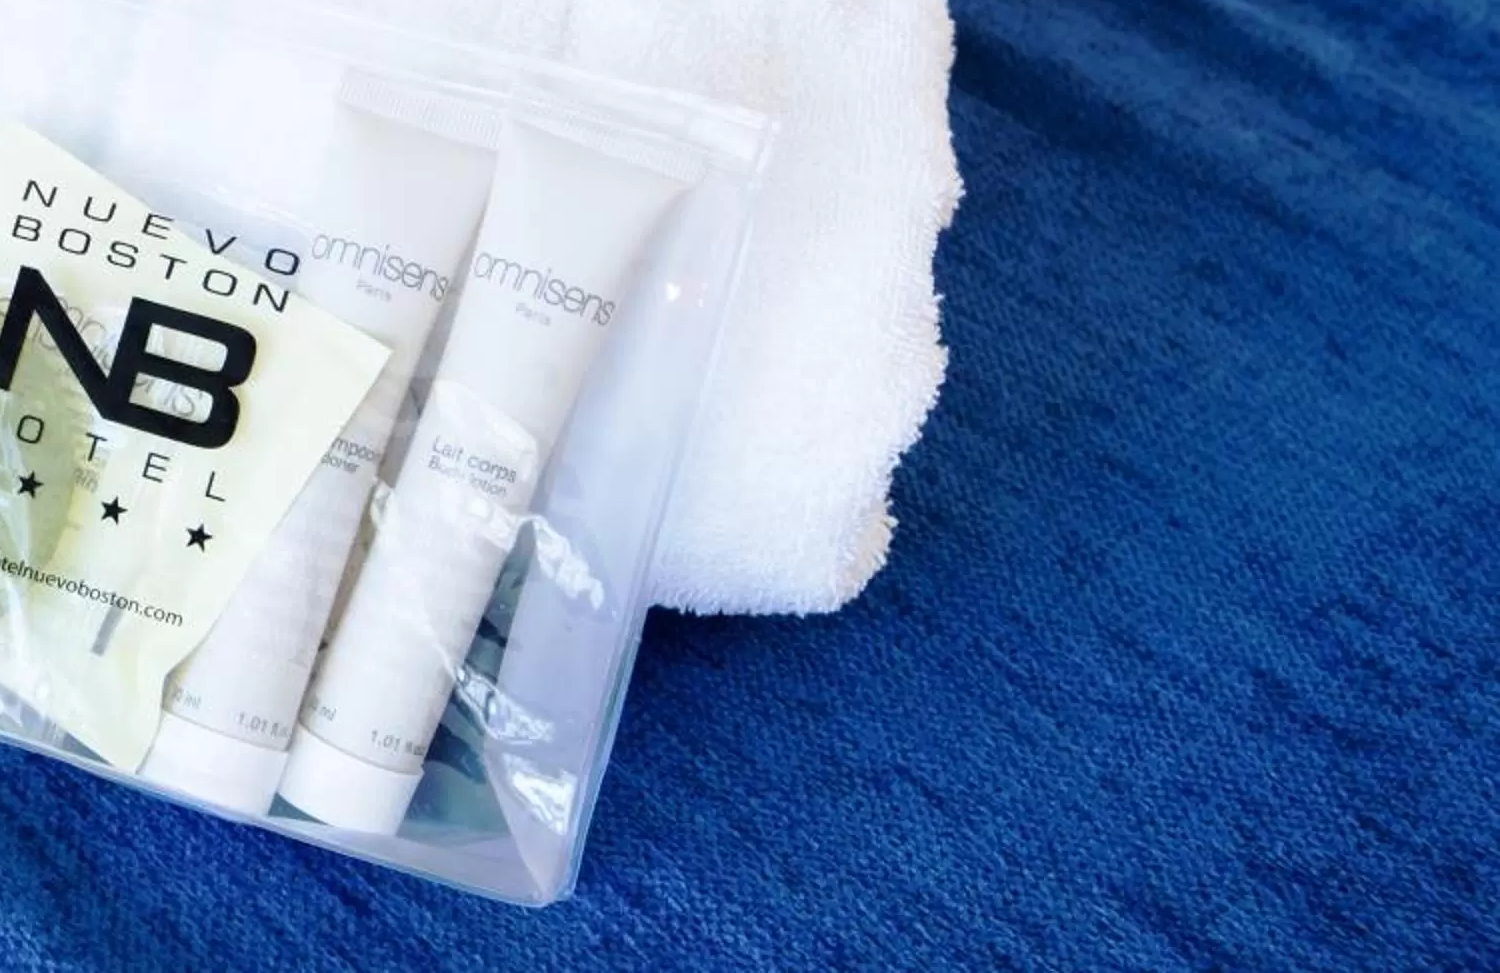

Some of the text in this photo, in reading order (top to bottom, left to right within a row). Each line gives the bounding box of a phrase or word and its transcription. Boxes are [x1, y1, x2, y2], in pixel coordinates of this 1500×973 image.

[11, 214, 290, 314] BOSTON
[22, 179, 300, 276] NUEVO
[310, 233, 450, 302] omnisens
[473, 251, 616, 326] omnisens
[432, 435, 517, 484] Lait corps
